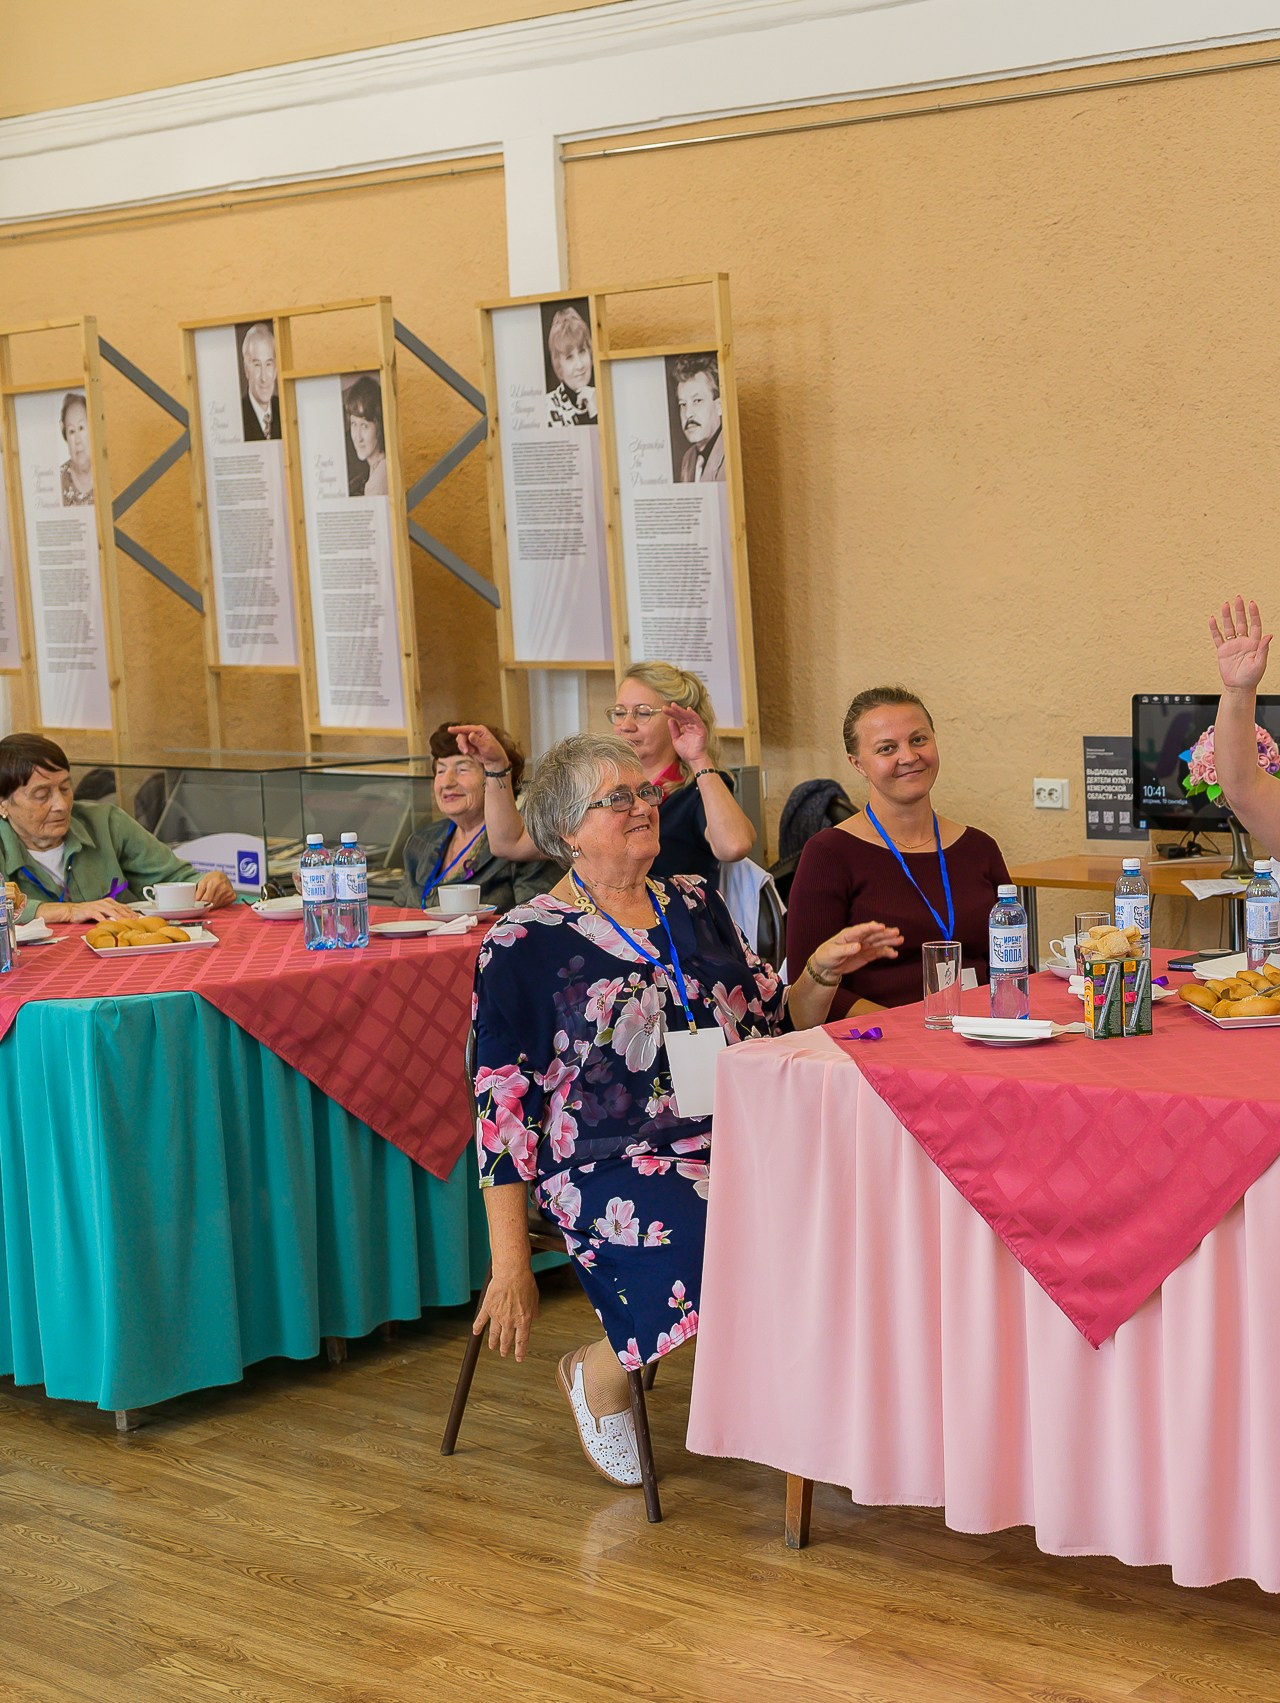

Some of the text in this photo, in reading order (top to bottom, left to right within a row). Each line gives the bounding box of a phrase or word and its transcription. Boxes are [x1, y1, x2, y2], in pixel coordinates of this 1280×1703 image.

[1086, 768, 1128, 776] ВЫДАЮЩИЕСЯ
[1086, 776, 1112, 784] ДЕЯТЕЛИ
[1086, 784, 1127, 792] КЕМЕРОВСКОЙ
[1143, 785, 1166, 797] 10:41
[1003, 948, 1022, 963] ВОДА
